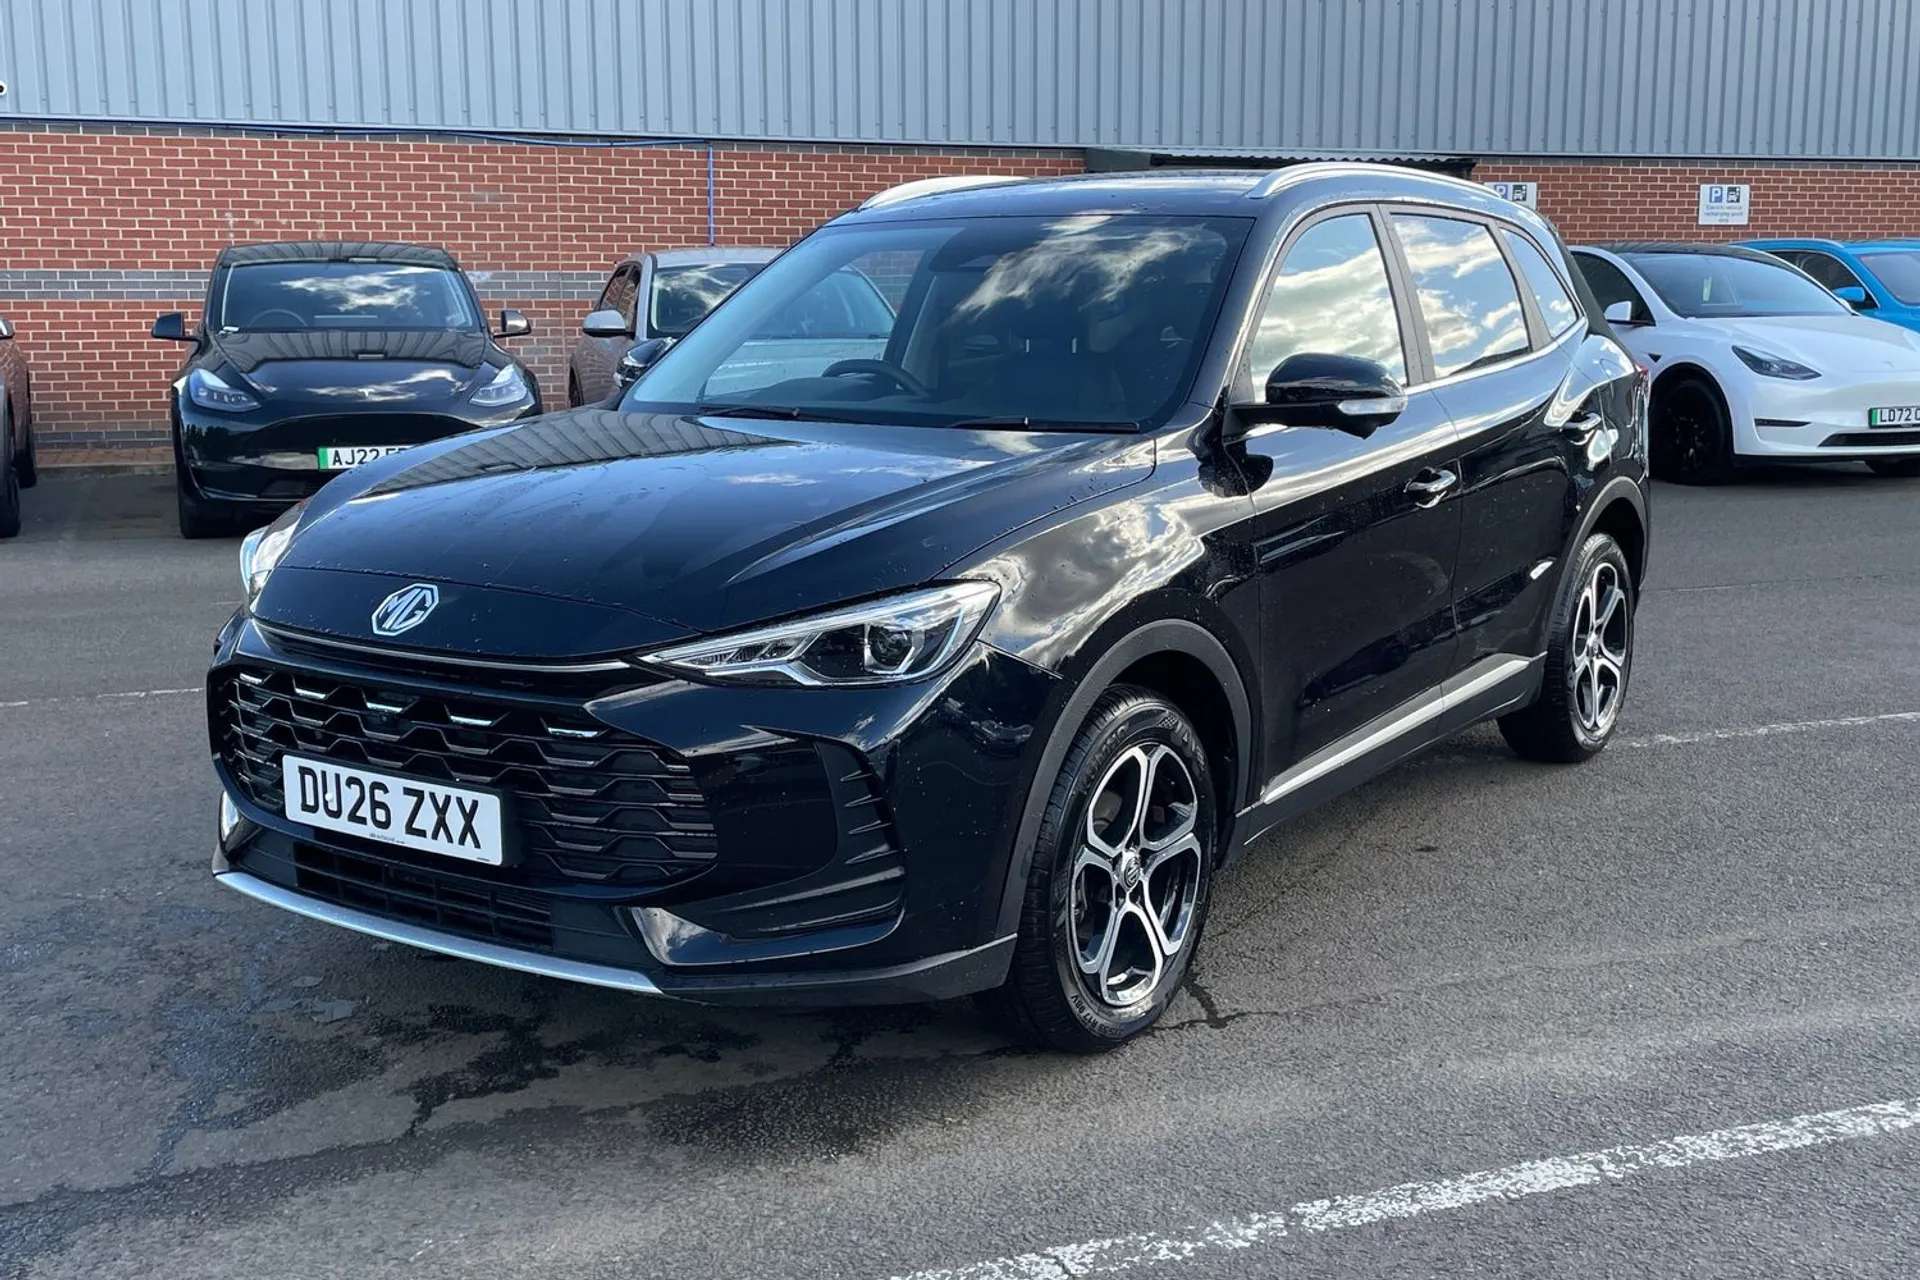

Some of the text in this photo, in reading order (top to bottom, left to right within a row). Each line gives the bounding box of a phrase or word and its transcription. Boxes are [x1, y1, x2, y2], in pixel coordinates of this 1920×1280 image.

[1880, 408, 1912, 422] LD72
[332, 448, 380, 466] AJ22
[377, 586, 435, 632] MG
[298, 765, 482, 850] DU26 ZXX
